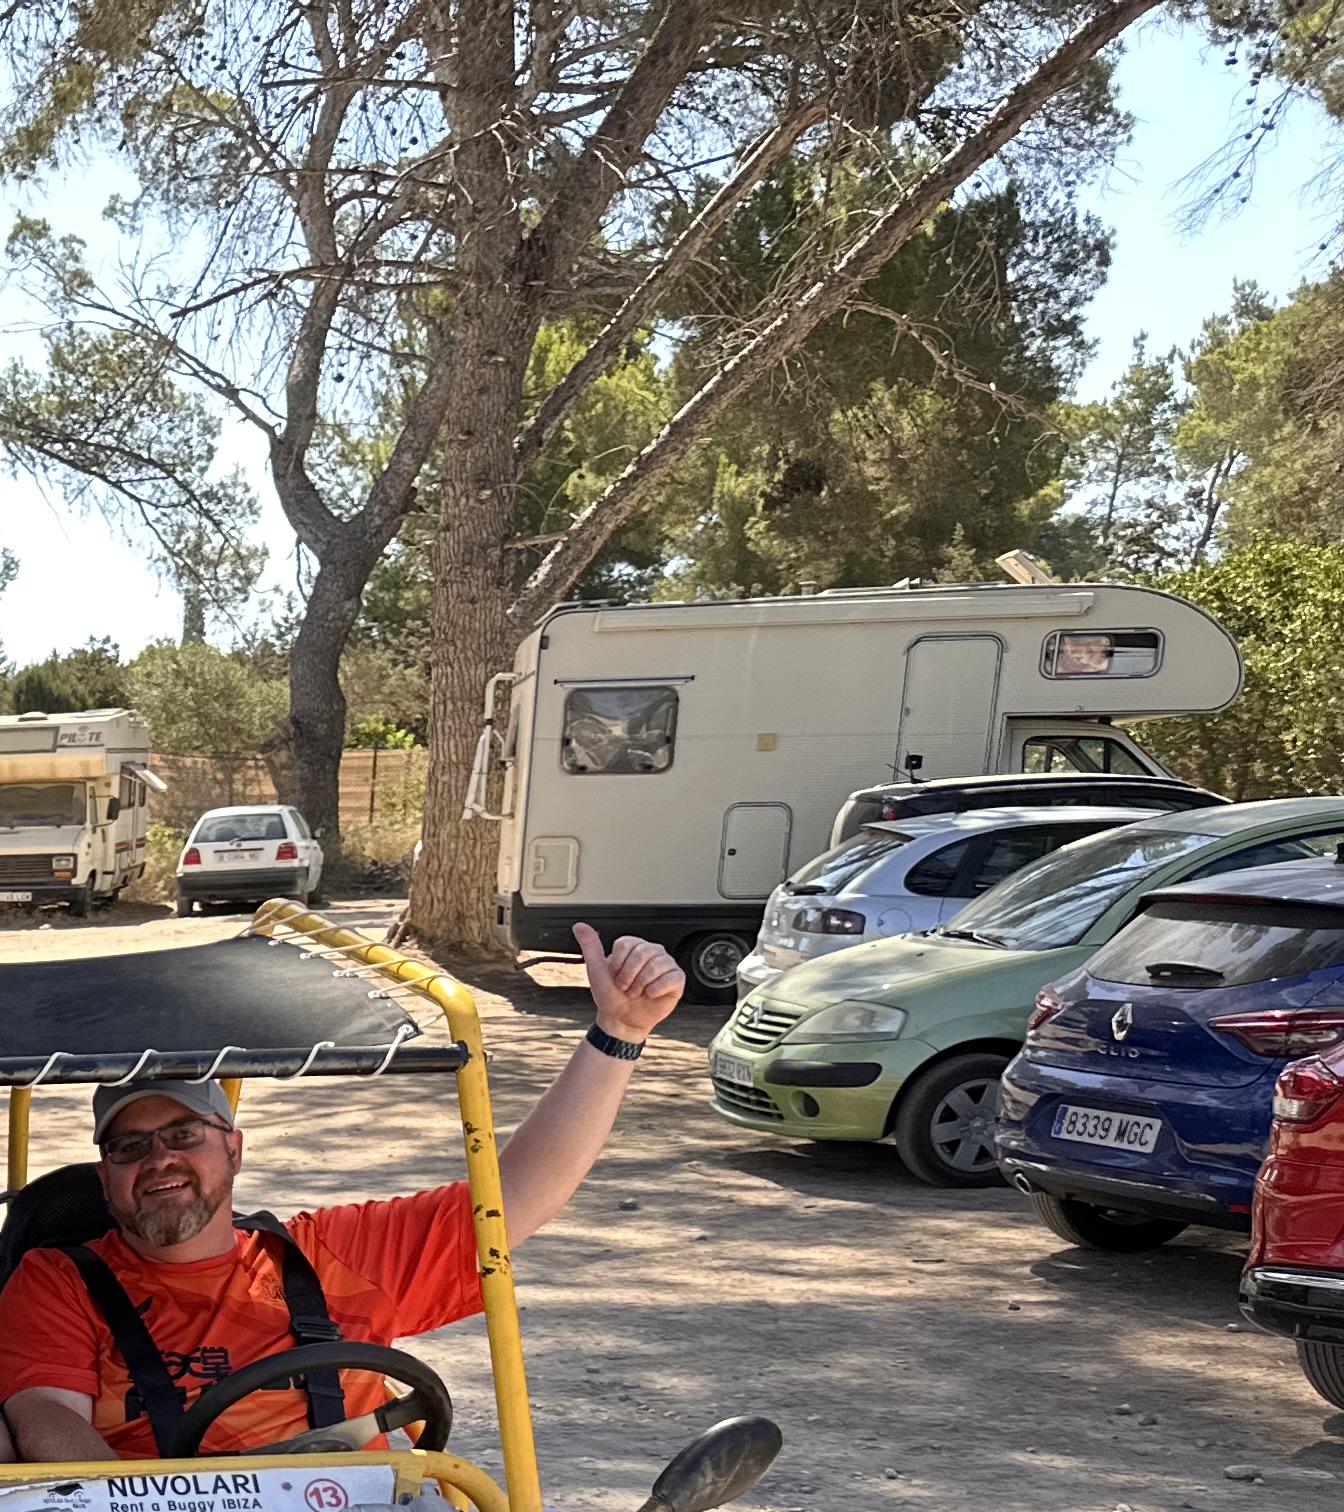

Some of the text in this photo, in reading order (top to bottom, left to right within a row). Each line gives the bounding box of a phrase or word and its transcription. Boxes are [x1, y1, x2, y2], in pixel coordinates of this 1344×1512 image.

[1097, 1044, 1140, 1059] CLIO
[1065, 1111, 1154, 1147] 8339 MGC
[107, 1473, 261, 1498] NUVOLARI
[110, 1501, 144, 1512] Rent
[151, 1503, 160, 1512] a
[222, 1497, 263, 1510] IBIZA
[309, 1486, 342, 1509] 13
